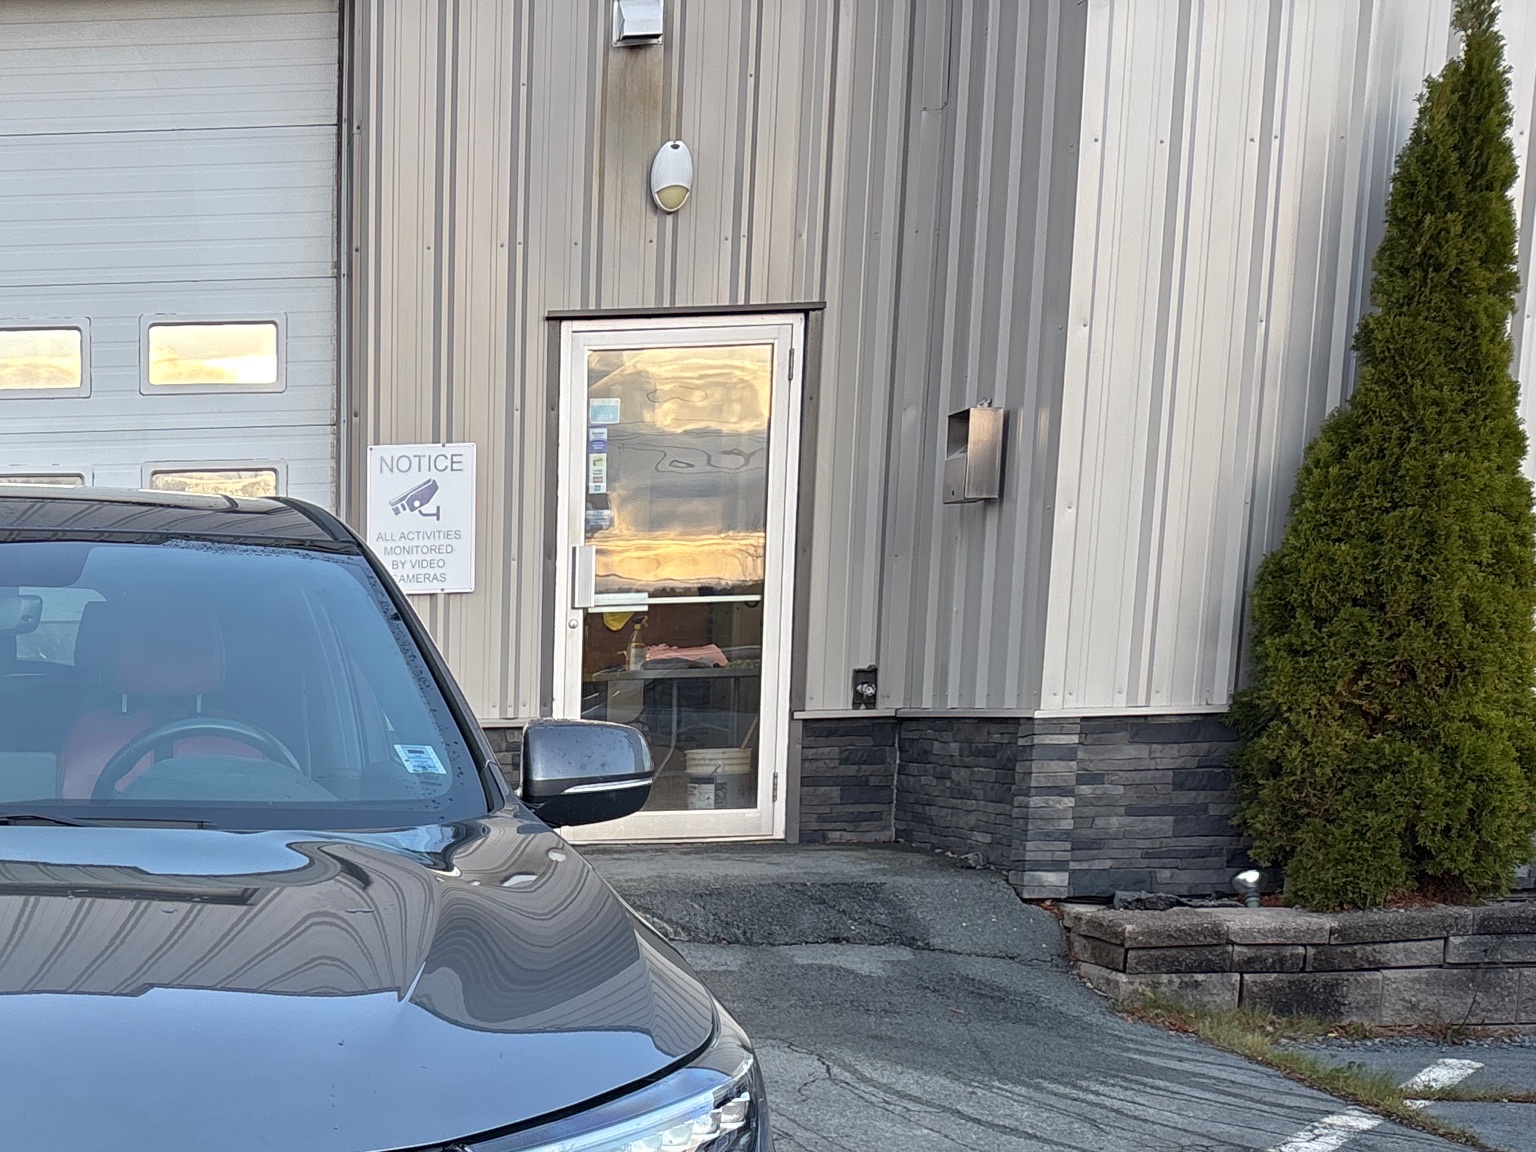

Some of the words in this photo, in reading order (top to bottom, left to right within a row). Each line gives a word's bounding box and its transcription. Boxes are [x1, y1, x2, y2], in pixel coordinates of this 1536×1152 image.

[379, 454, 464, 473] NOTICE
[376, 532, 396, 542] ALL
[399, 530, 461, 541] ACTIVITIES
[384, 544, 454, 555] MONITORED
[391, 560, 407, 570] BY
[410, 559, 446, 569] VIDEO
